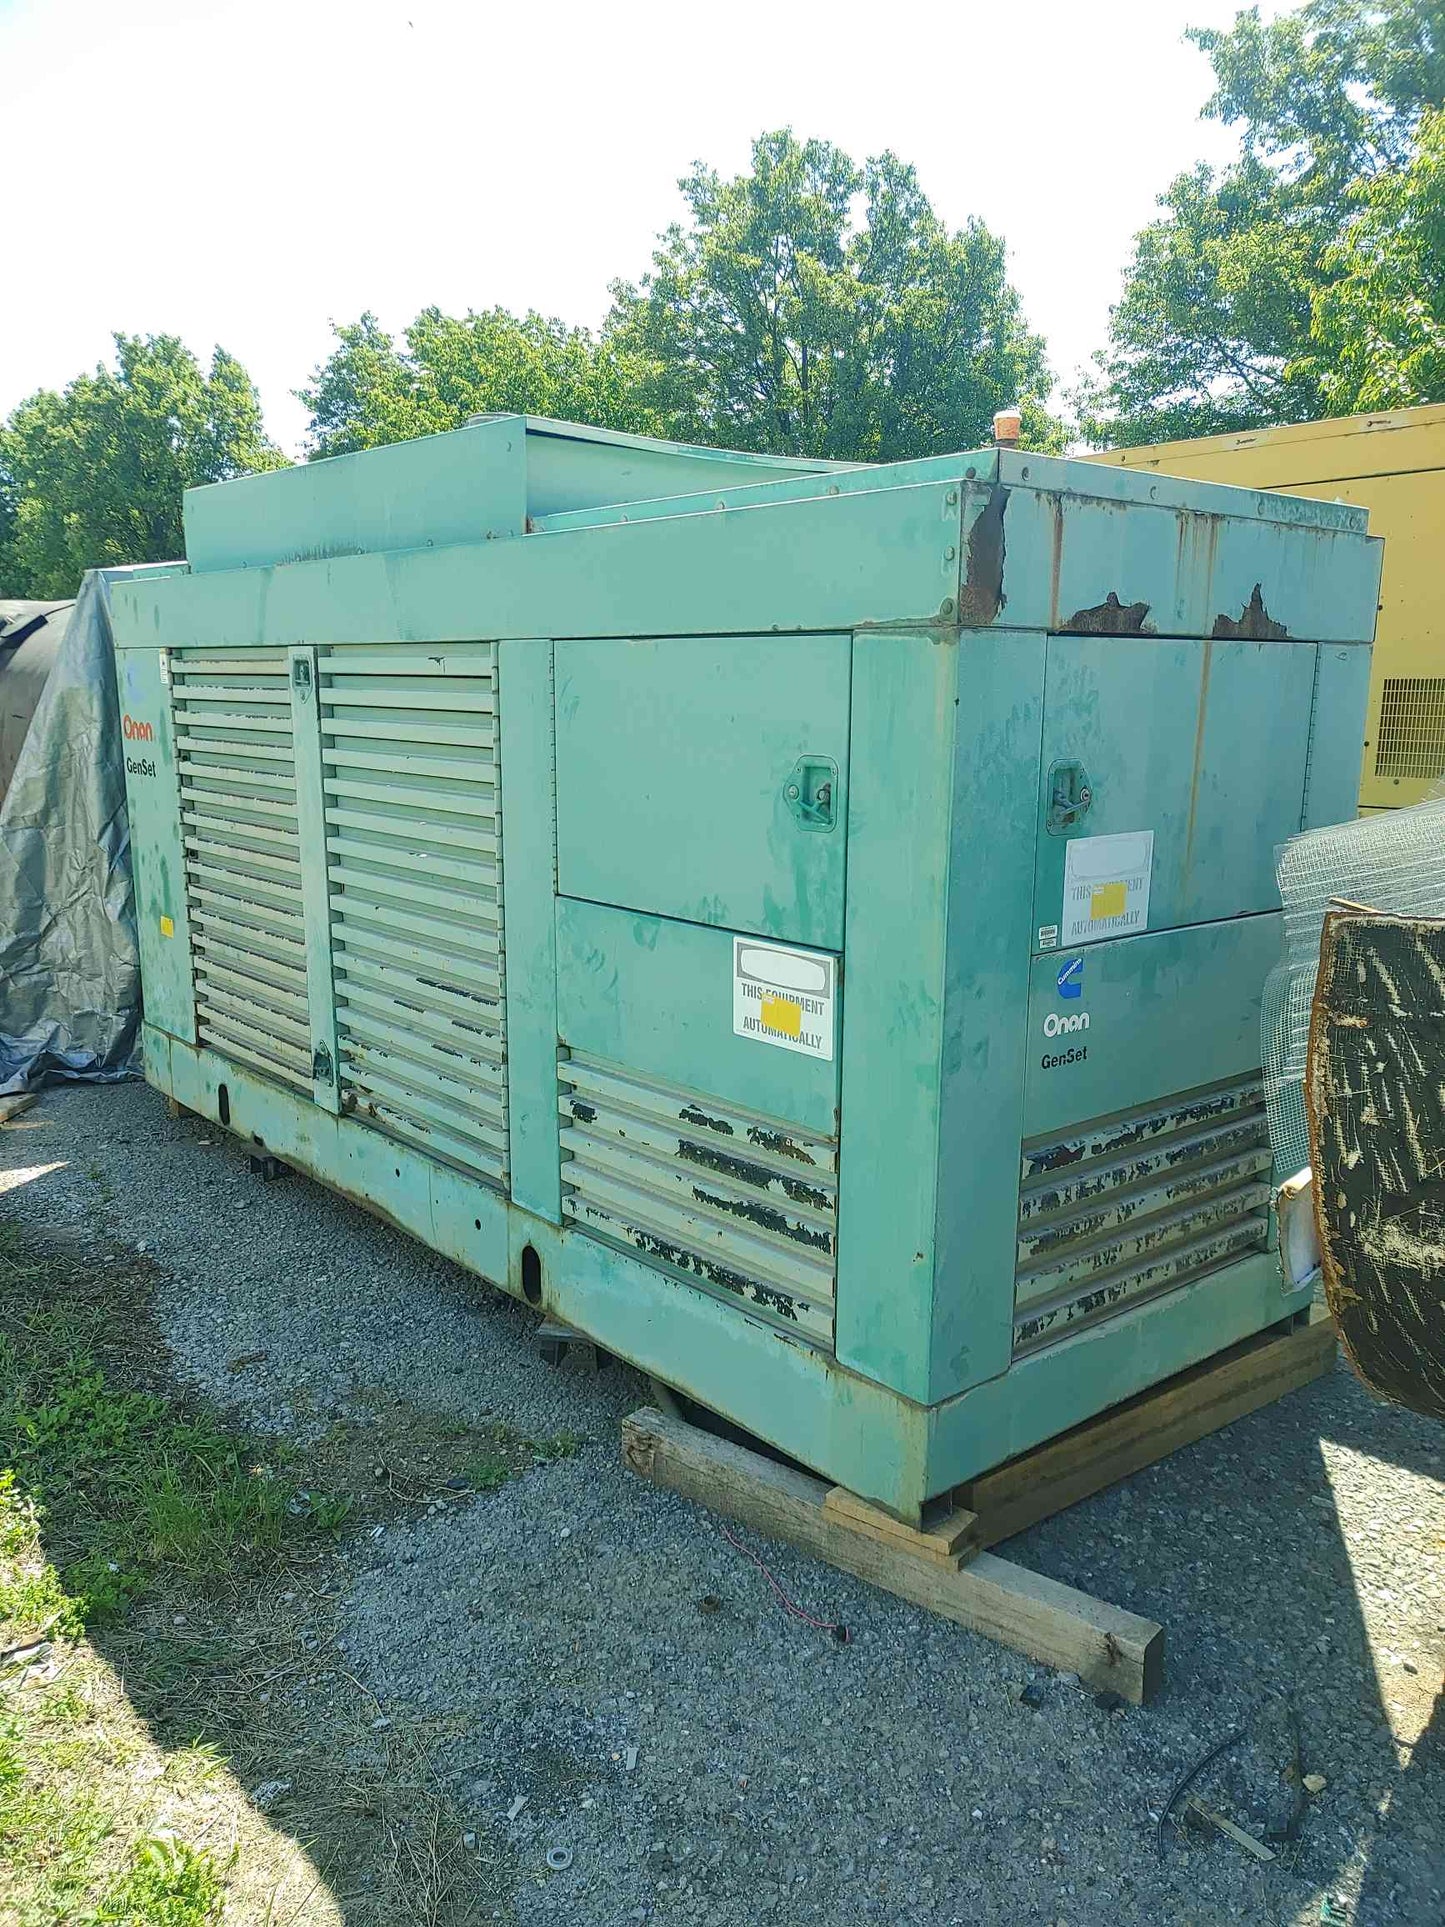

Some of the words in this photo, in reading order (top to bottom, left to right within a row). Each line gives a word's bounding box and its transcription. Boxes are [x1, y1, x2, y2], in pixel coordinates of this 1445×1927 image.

[124, 715, 152, 740] Onan
[127, 757, 156, 777] GenSet
[741, 983, 763, 1000] THIS
[1043, 1012, 1090, 1038] Onan
[1041, 1046, 1087, 1069] GenSet
